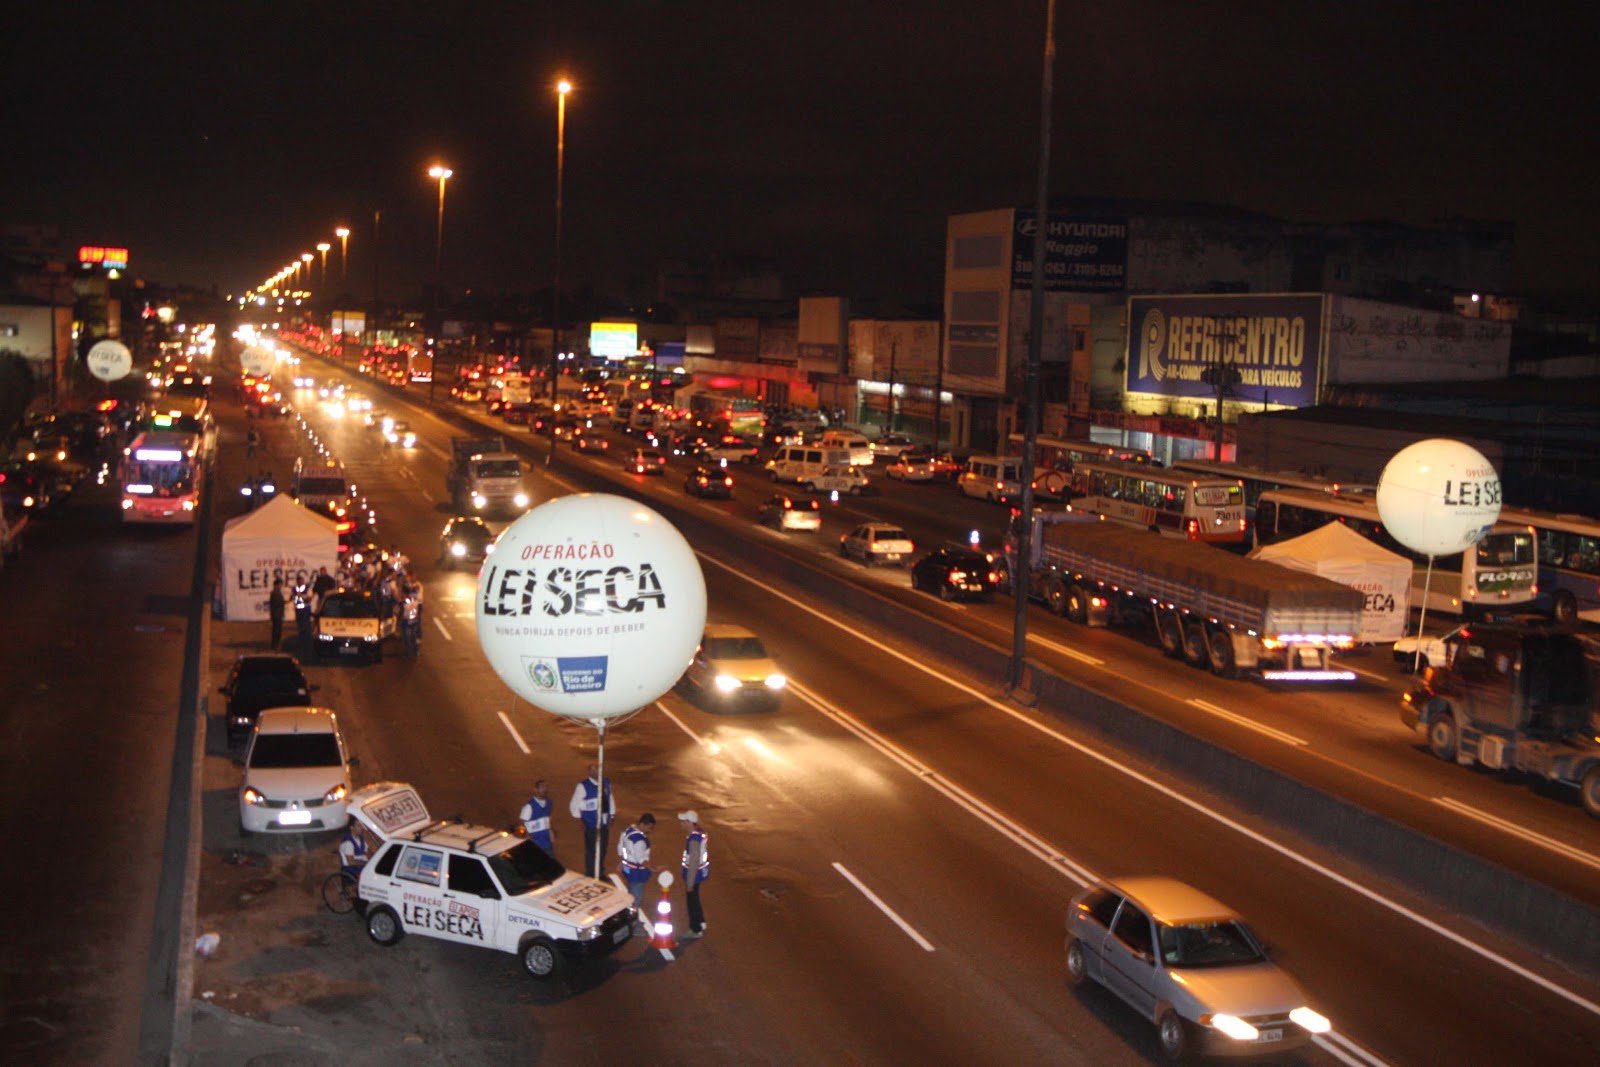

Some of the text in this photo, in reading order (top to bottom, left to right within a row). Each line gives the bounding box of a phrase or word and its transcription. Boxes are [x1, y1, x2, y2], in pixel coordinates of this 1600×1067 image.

[1049, 221, 1126, 238] HYUNDAI
[1167, 316, 1305, 367] REFRICENTRO
[1261, 366, 1302, 388] VEÍCULOS
[1444, 480, 1480, 506] LEI
[520, 540, 615, 561] OPERAÇÃO
[239, 569, 268, 590] LEI
[484, 563, 666, 618] LEI SECA
[557, 627, 593, 637] DEPOIS
[597, 625, 609, 635] DE
[614, 622, 646, 634] BEBER
[563, 674, 595, 684] Rio de
[565, 682, 602, 690] Janeiro
[403, 902, 484, 940] LEI SECA
[508, 914, 540, 928] DETRAN
